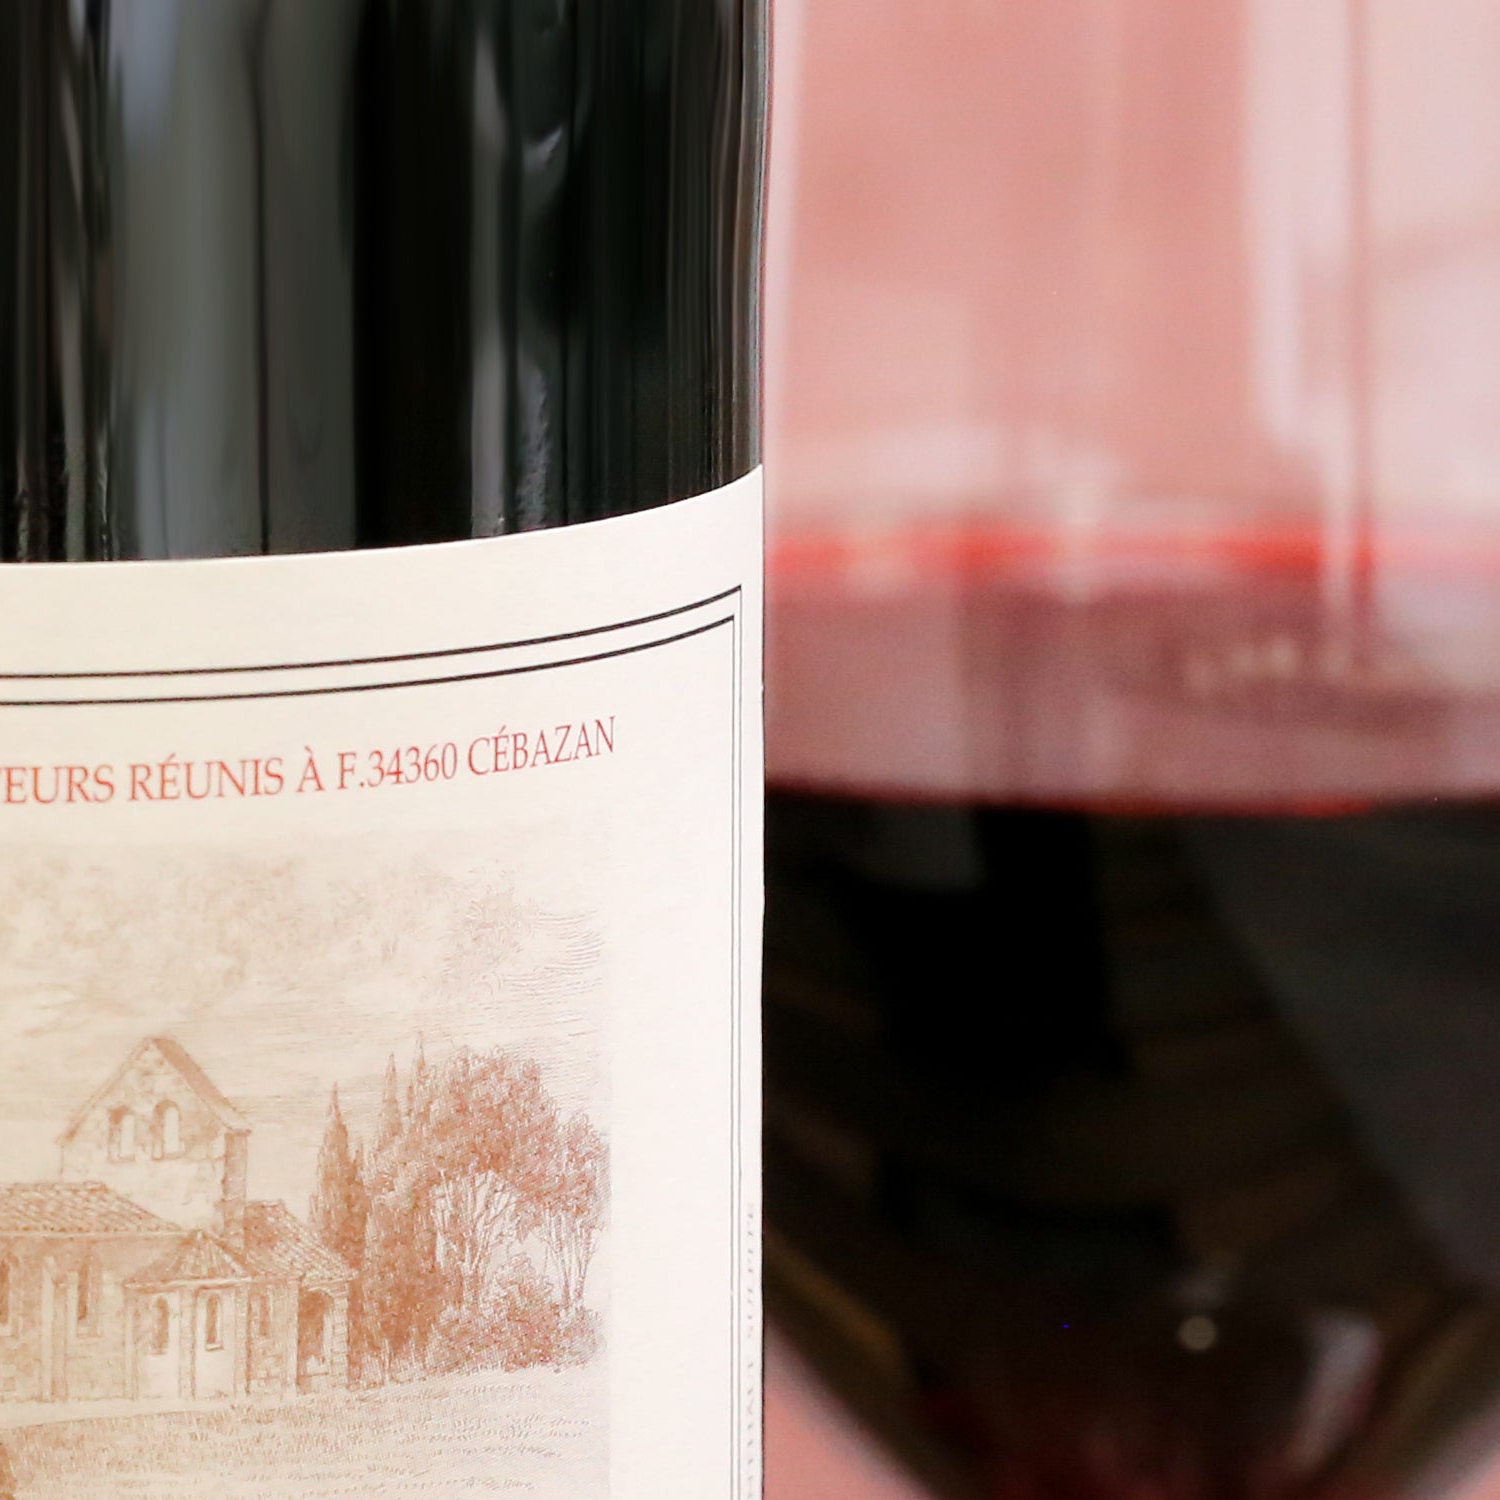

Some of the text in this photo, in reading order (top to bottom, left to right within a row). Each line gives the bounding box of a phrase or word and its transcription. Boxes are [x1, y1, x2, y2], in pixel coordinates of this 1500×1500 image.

[128, 753, 285, 801] RÉUNIS
[296, 745, 325, 793] À
[337, 742, 458, 790] F.34360
[467, 715, 615, 776] CÉBAZAN
